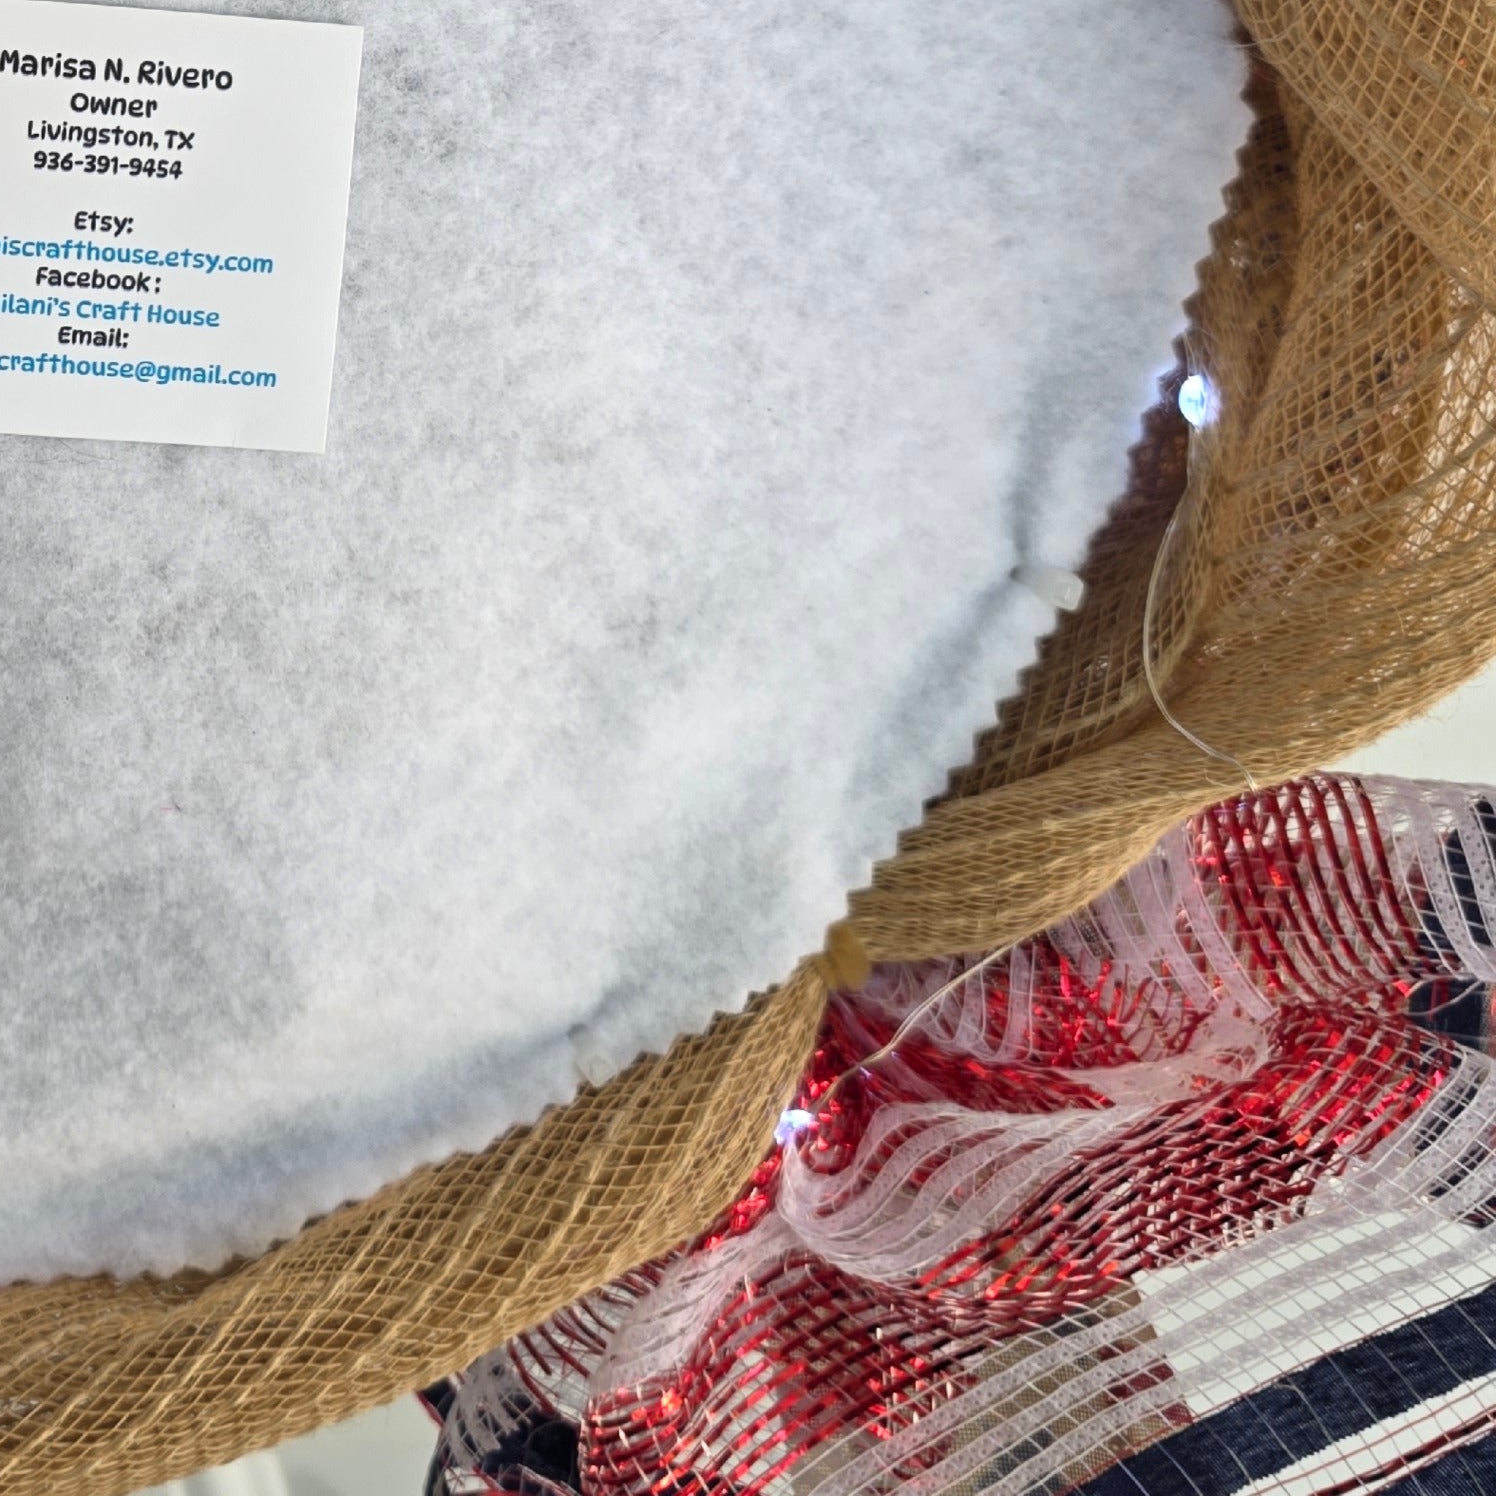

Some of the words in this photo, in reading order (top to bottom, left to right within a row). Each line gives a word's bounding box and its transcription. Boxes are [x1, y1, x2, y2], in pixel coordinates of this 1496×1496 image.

[104, 58, 131, 84] N.
[137, 61, 233, 90] Rivero
[69, 92, 158, 118] Owner
[27, 120, 159, 150] Livingston,
[164, 130, 195, 150] TX
[33, 150, 183, 179] 936-391-9454
[74, 211, 134, 236] Etsy:
[76, 301, 142, 322] Craft
[147, 305, 220, 327] House
[58, 326, 129, 349] Email:
